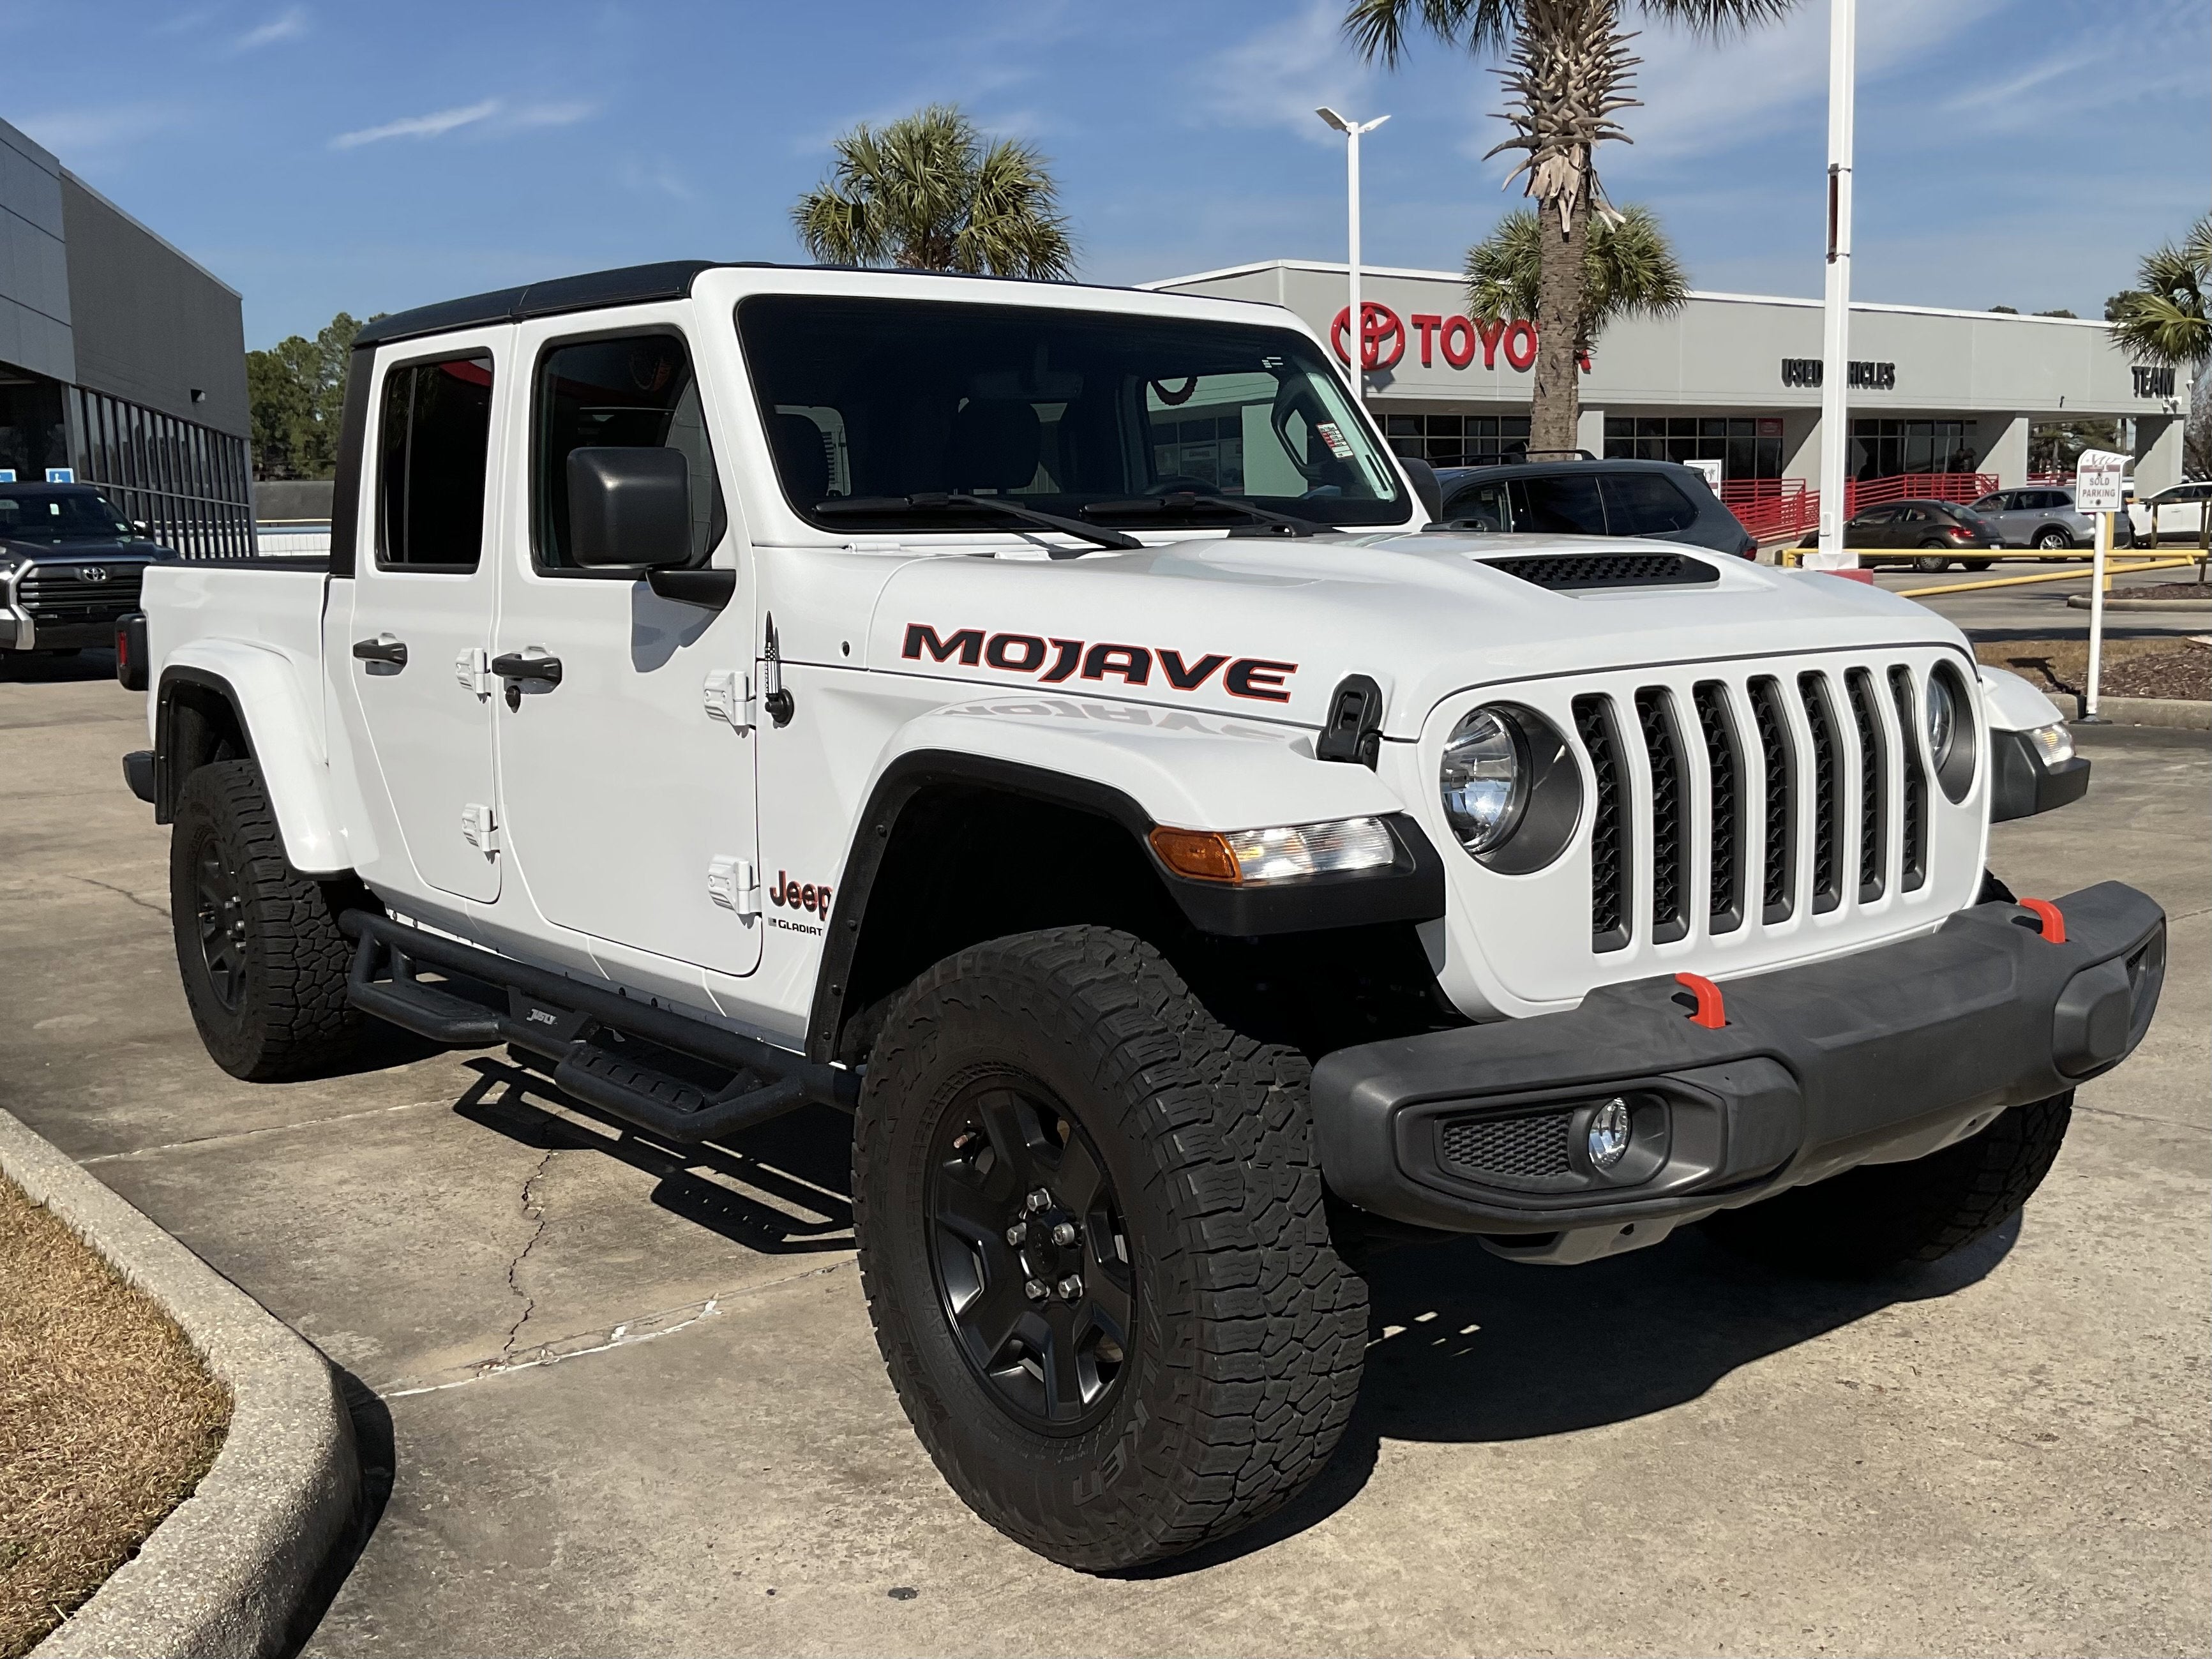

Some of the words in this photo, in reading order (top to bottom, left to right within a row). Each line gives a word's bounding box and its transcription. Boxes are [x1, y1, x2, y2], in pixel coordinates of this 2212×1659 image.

[1411, 314, 1591, 374] TOYO
[1782, 359, 1823, 387] USED
[1847, 361, 1895, 390] HICLES
[2131, 366, 2176, 398] TEAM
[2082, 489, 2116, 497] PARKING
[2089, 477, 2109, 486] SOLD
[901, 622, 1298, 703] MOJAVE
[769, 869, 833, 921] Jeep
[778, 920, 824, 936] GLADIAT
